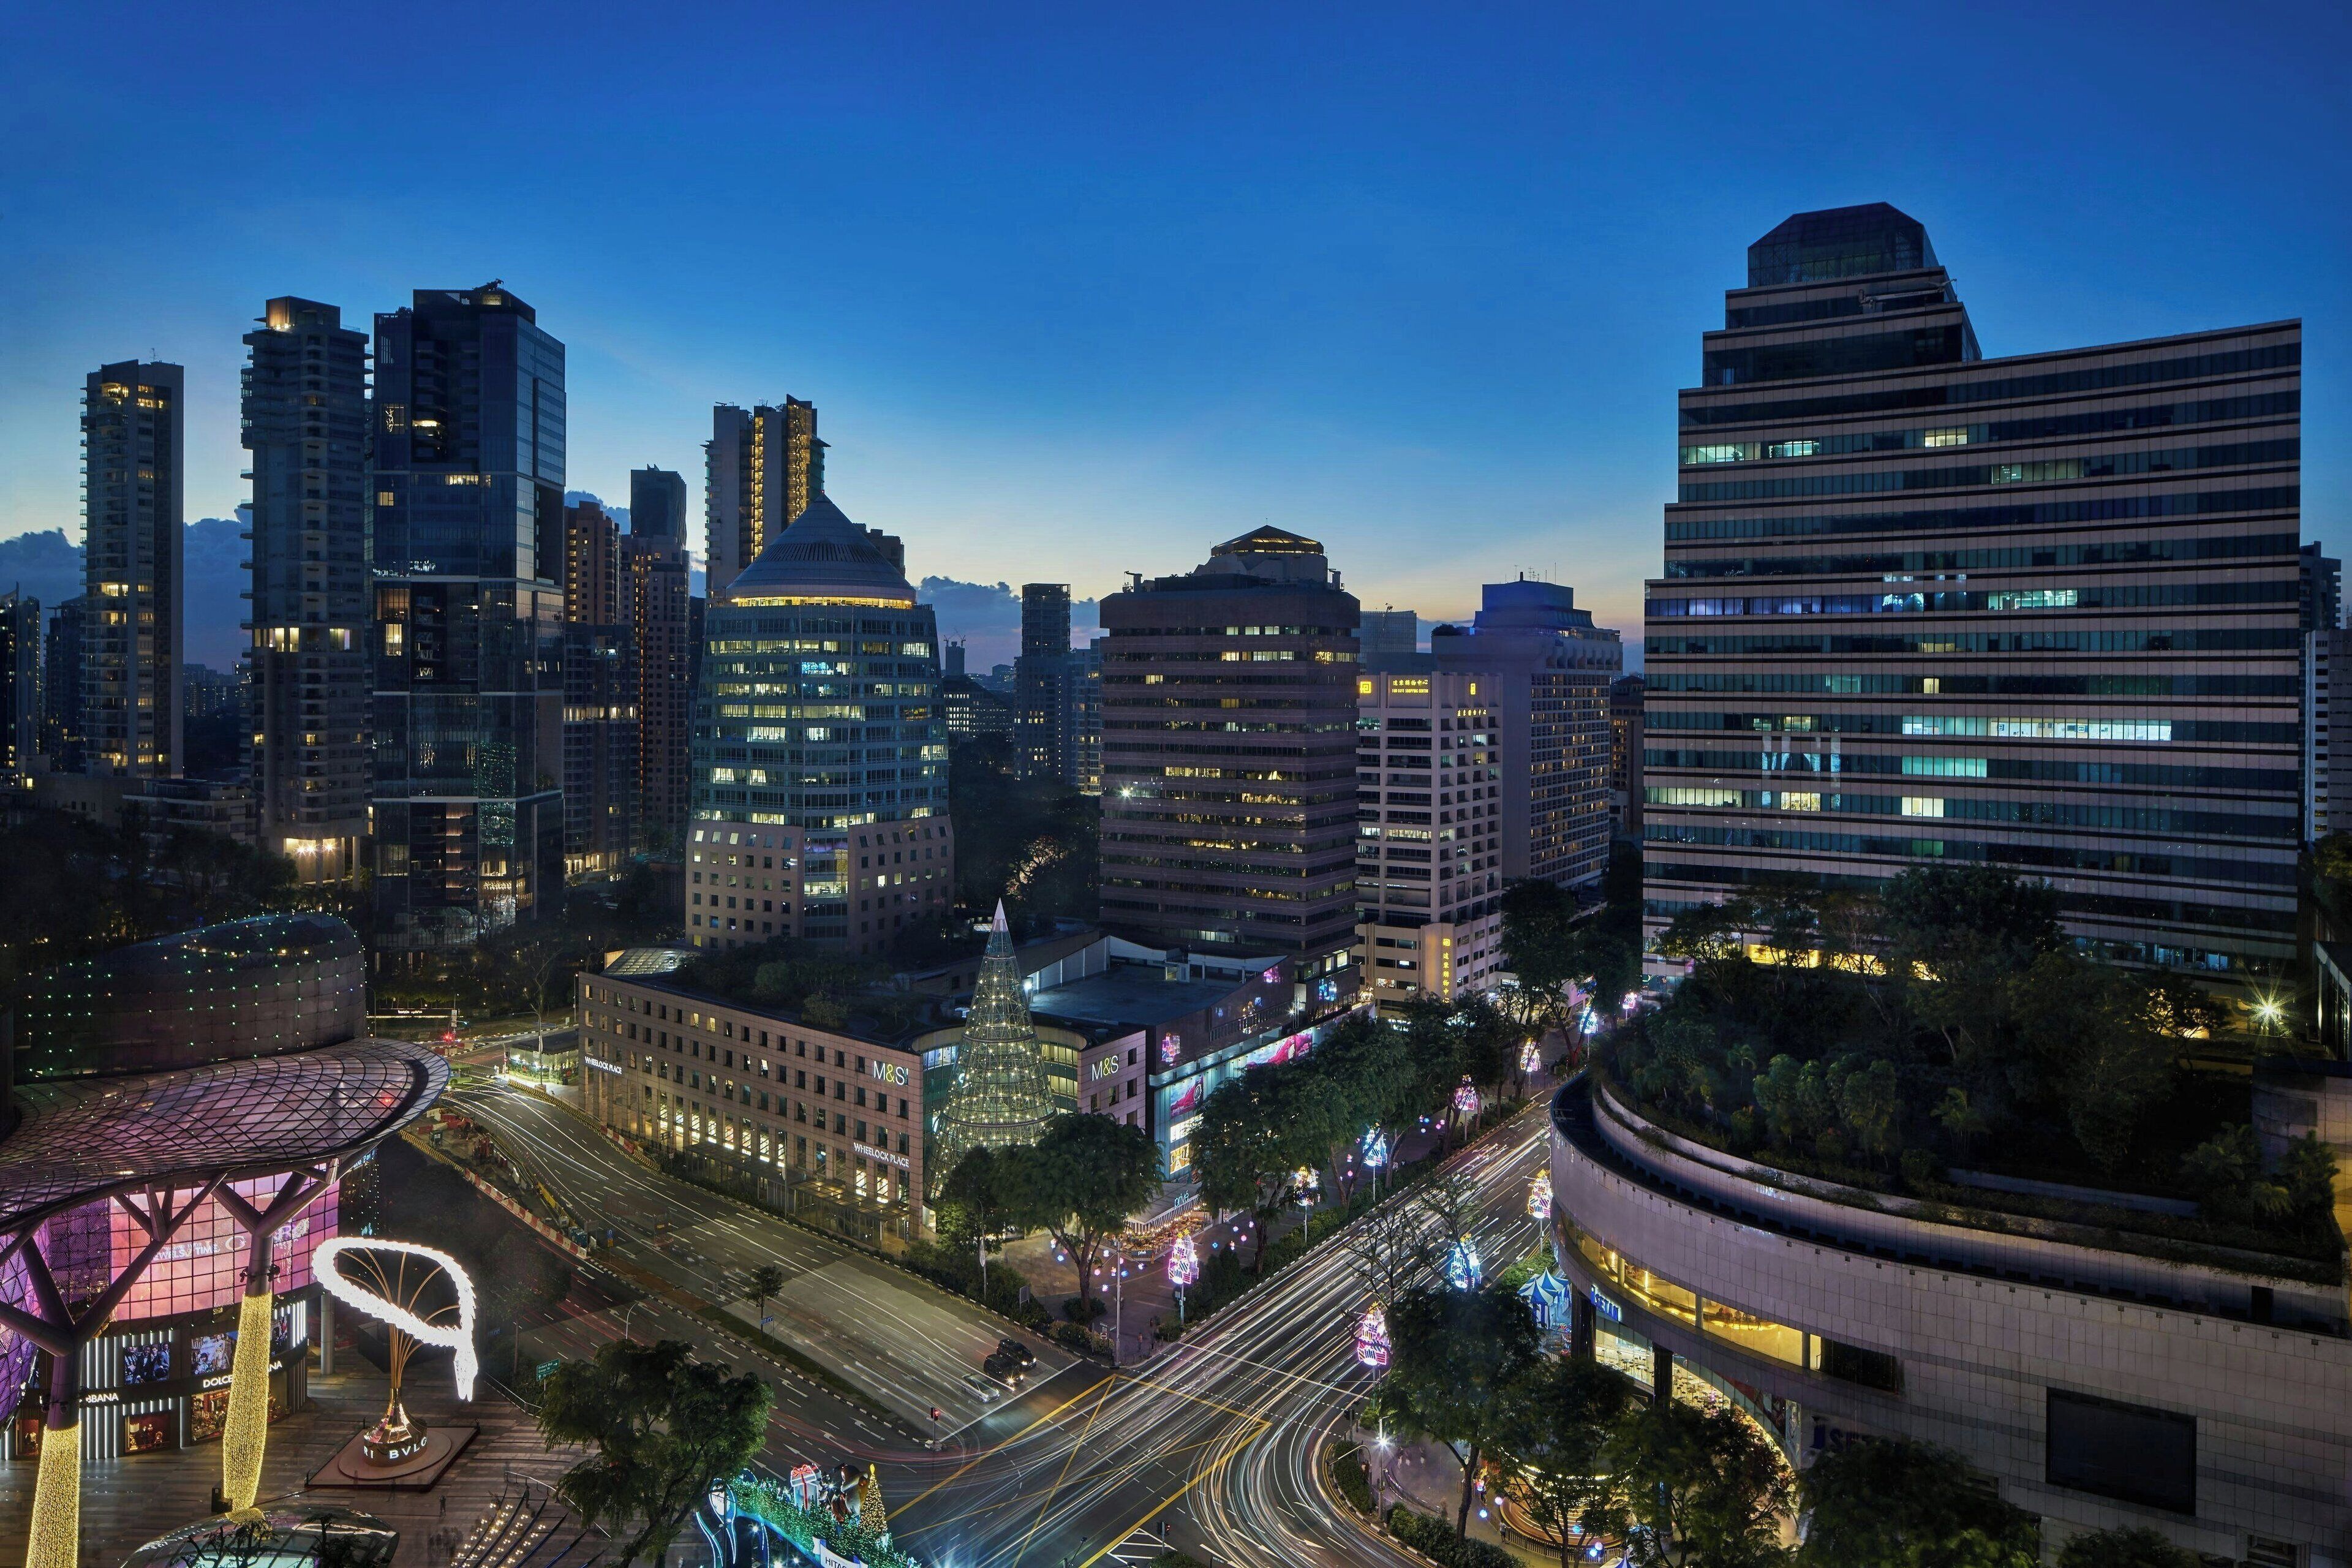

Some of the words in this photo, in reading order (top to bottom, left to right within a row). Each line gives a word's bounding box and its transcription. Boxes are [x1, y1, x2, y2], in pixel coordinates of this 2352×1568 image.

[584, 1056, 608, 1071] WHEELOCK
[609, 1064, 622, 1074] PLACE
[1092, 1055, 1118, 1081] M&S
[853, 1142, 889, 1162] WHEELOCK
[890, 1154, 909, 1168] PLACE
[1174, 1190, 1189, 1209] privé
[153, 1249, 185, 1262] EWELS
[203, 1374, 233, 1388] DOLCE
[85, 1393, 119, 1403] BBANA
[825, 1556, 846, 1568] HITA
